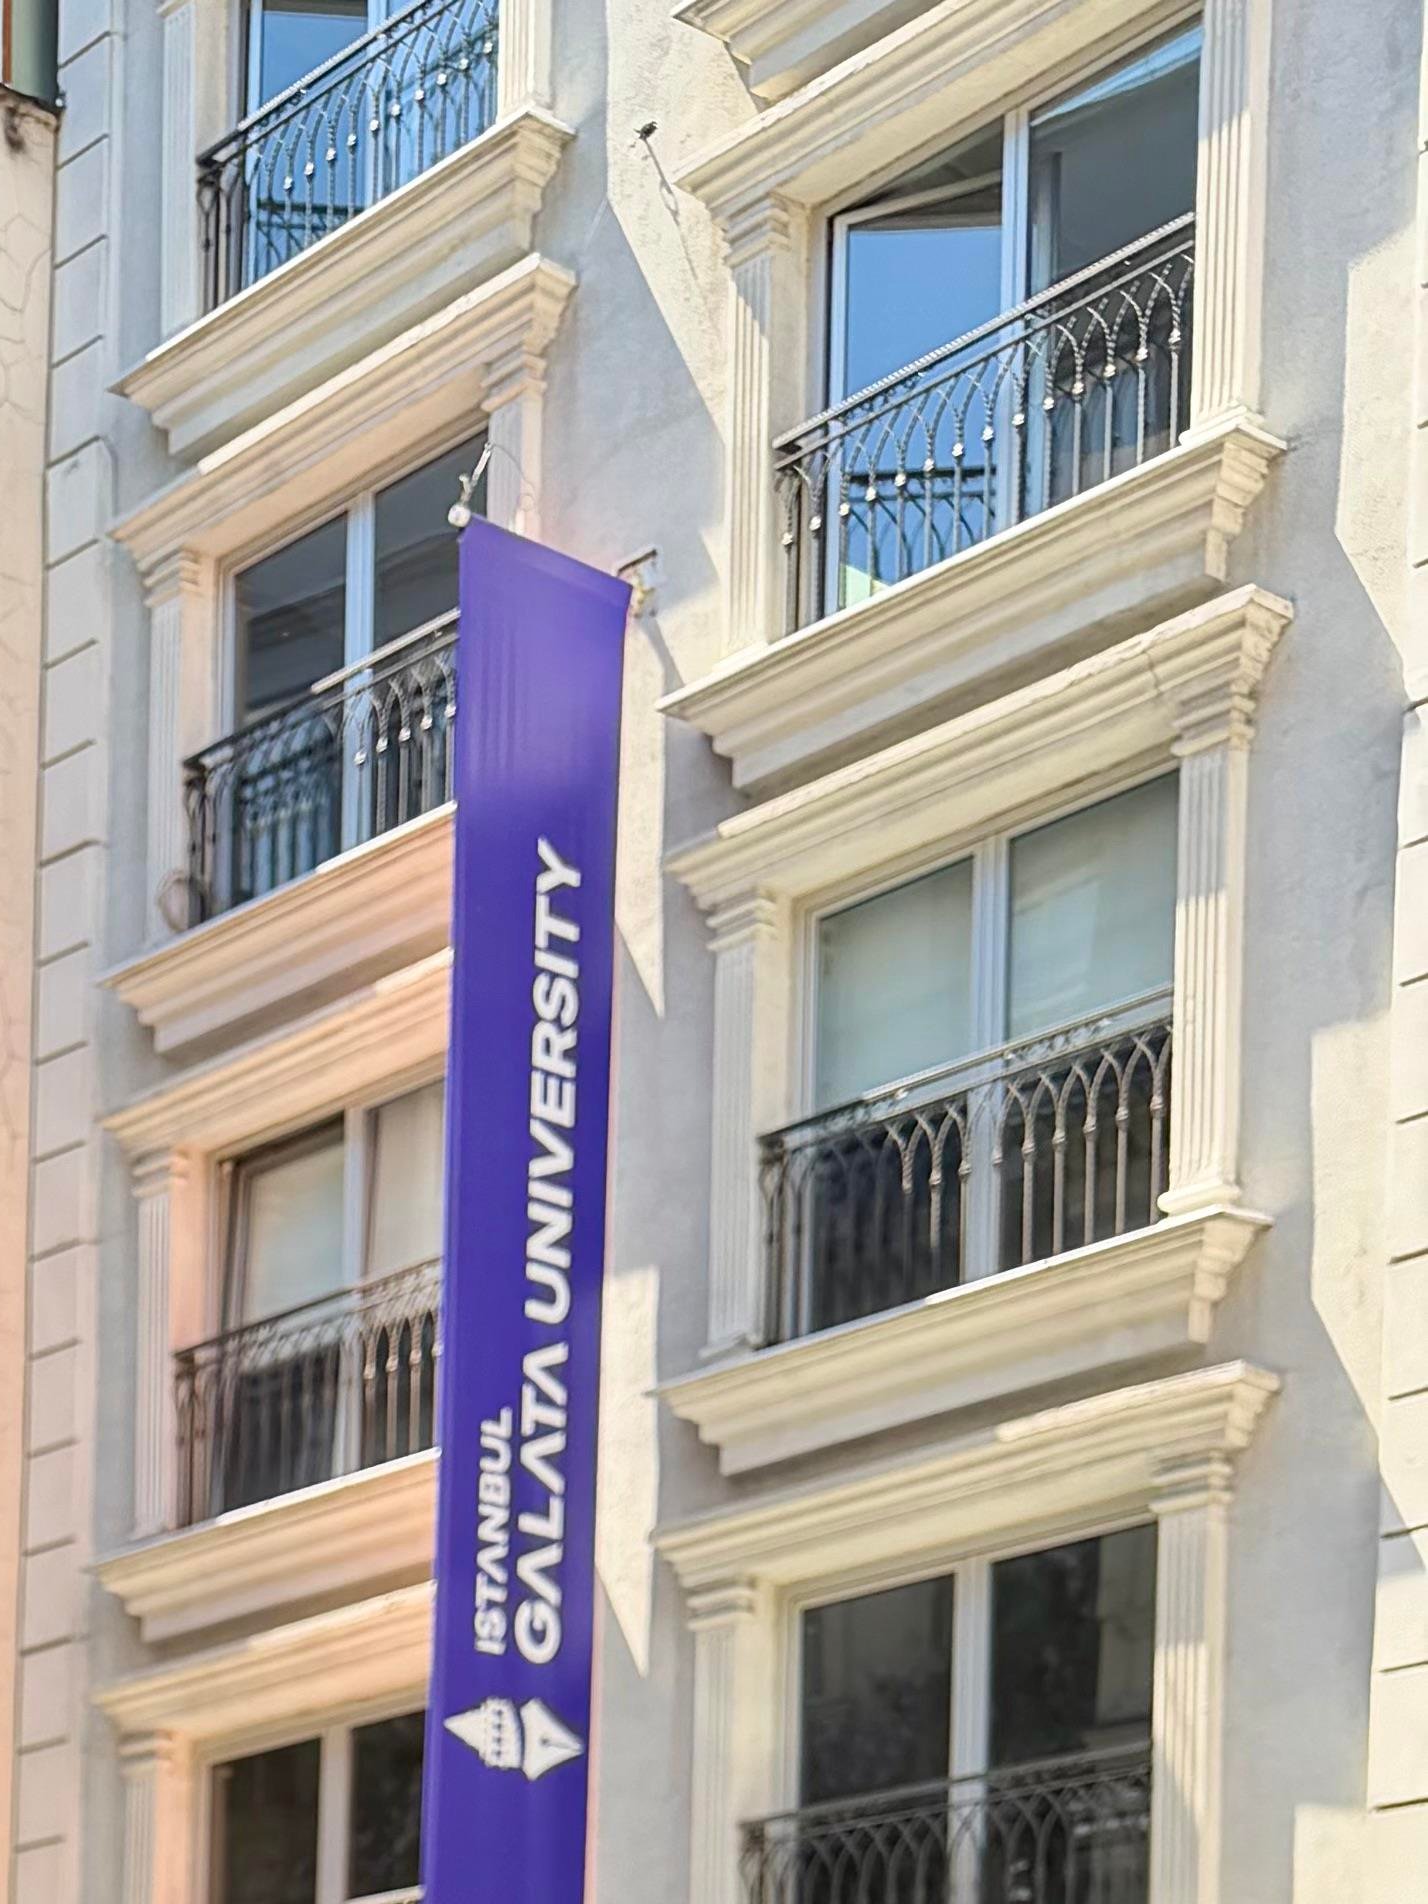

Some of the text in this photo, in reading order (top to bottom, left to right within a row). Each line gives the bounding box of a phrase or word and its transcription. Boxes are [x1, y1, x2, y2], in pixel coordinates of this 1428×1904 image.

[513, 838, 582, 1665] GALATA UNIVERSITY
[474, 1406, 513, 1656] ISTANBUL
